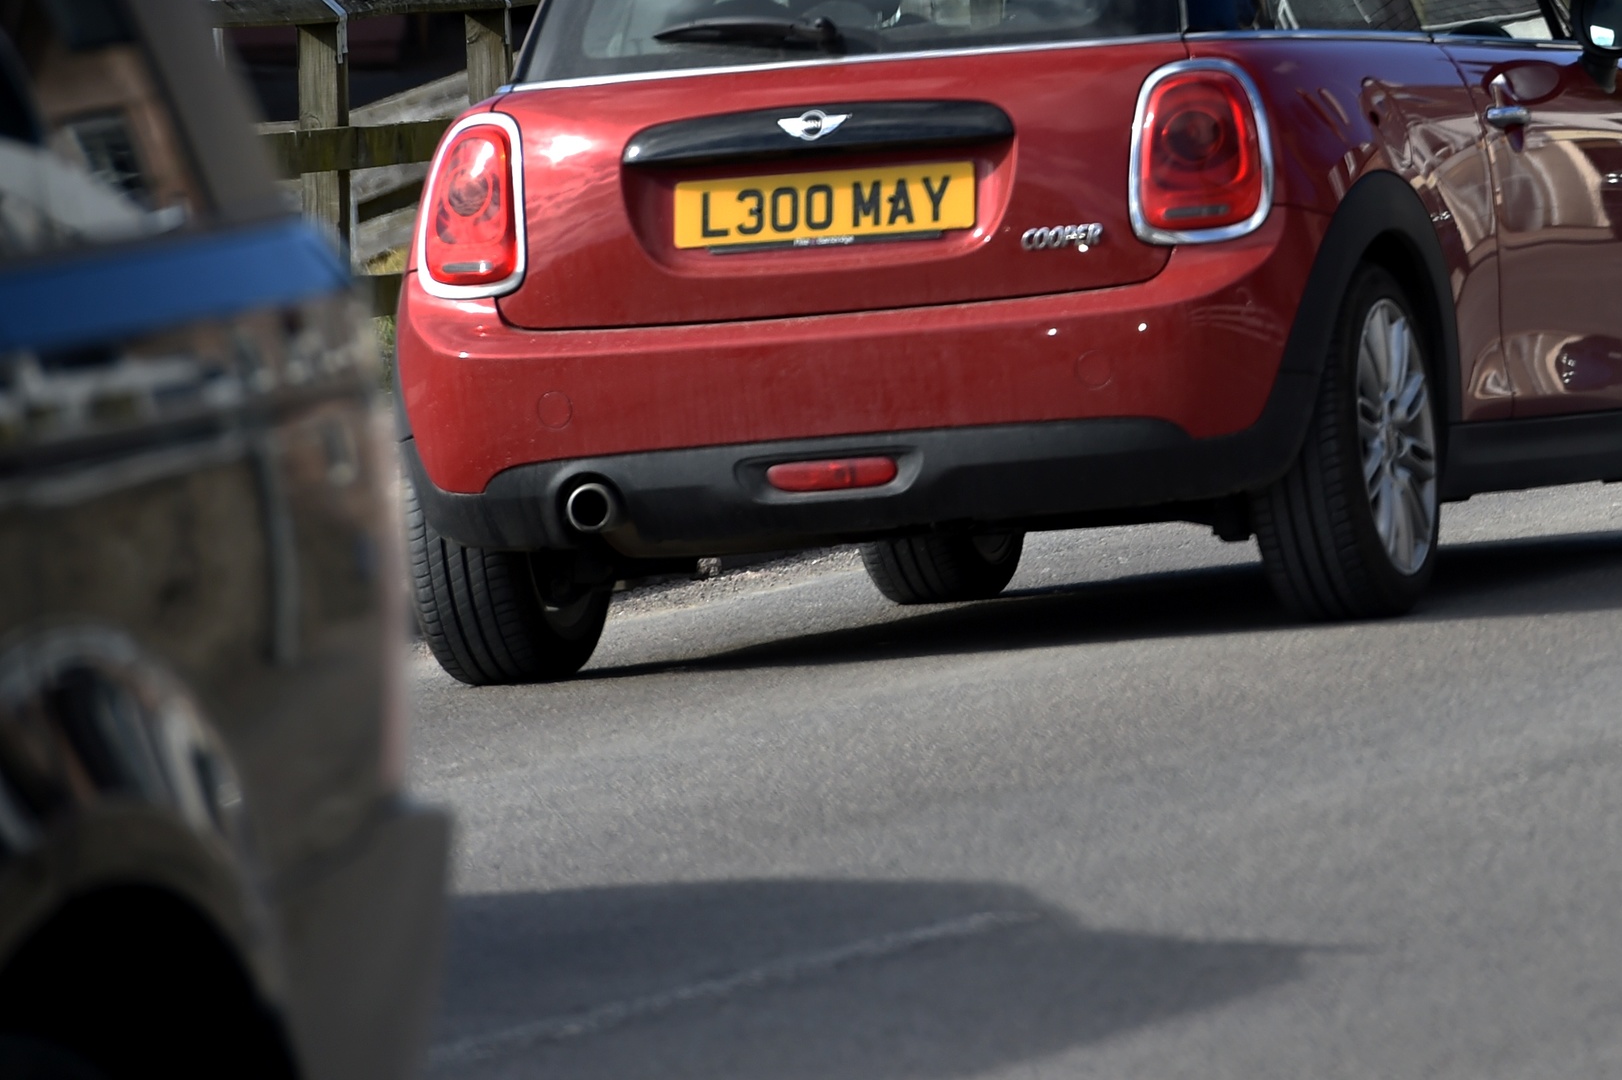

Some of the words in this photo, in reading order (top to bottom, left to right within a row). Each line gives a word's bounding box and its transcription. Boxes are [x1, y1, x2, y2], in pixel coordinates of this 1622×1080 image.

[702, 184, 833, 238] L300
[852, 175, 952, 228] MAY
[1020, 222, 1104, 251] COOPER
